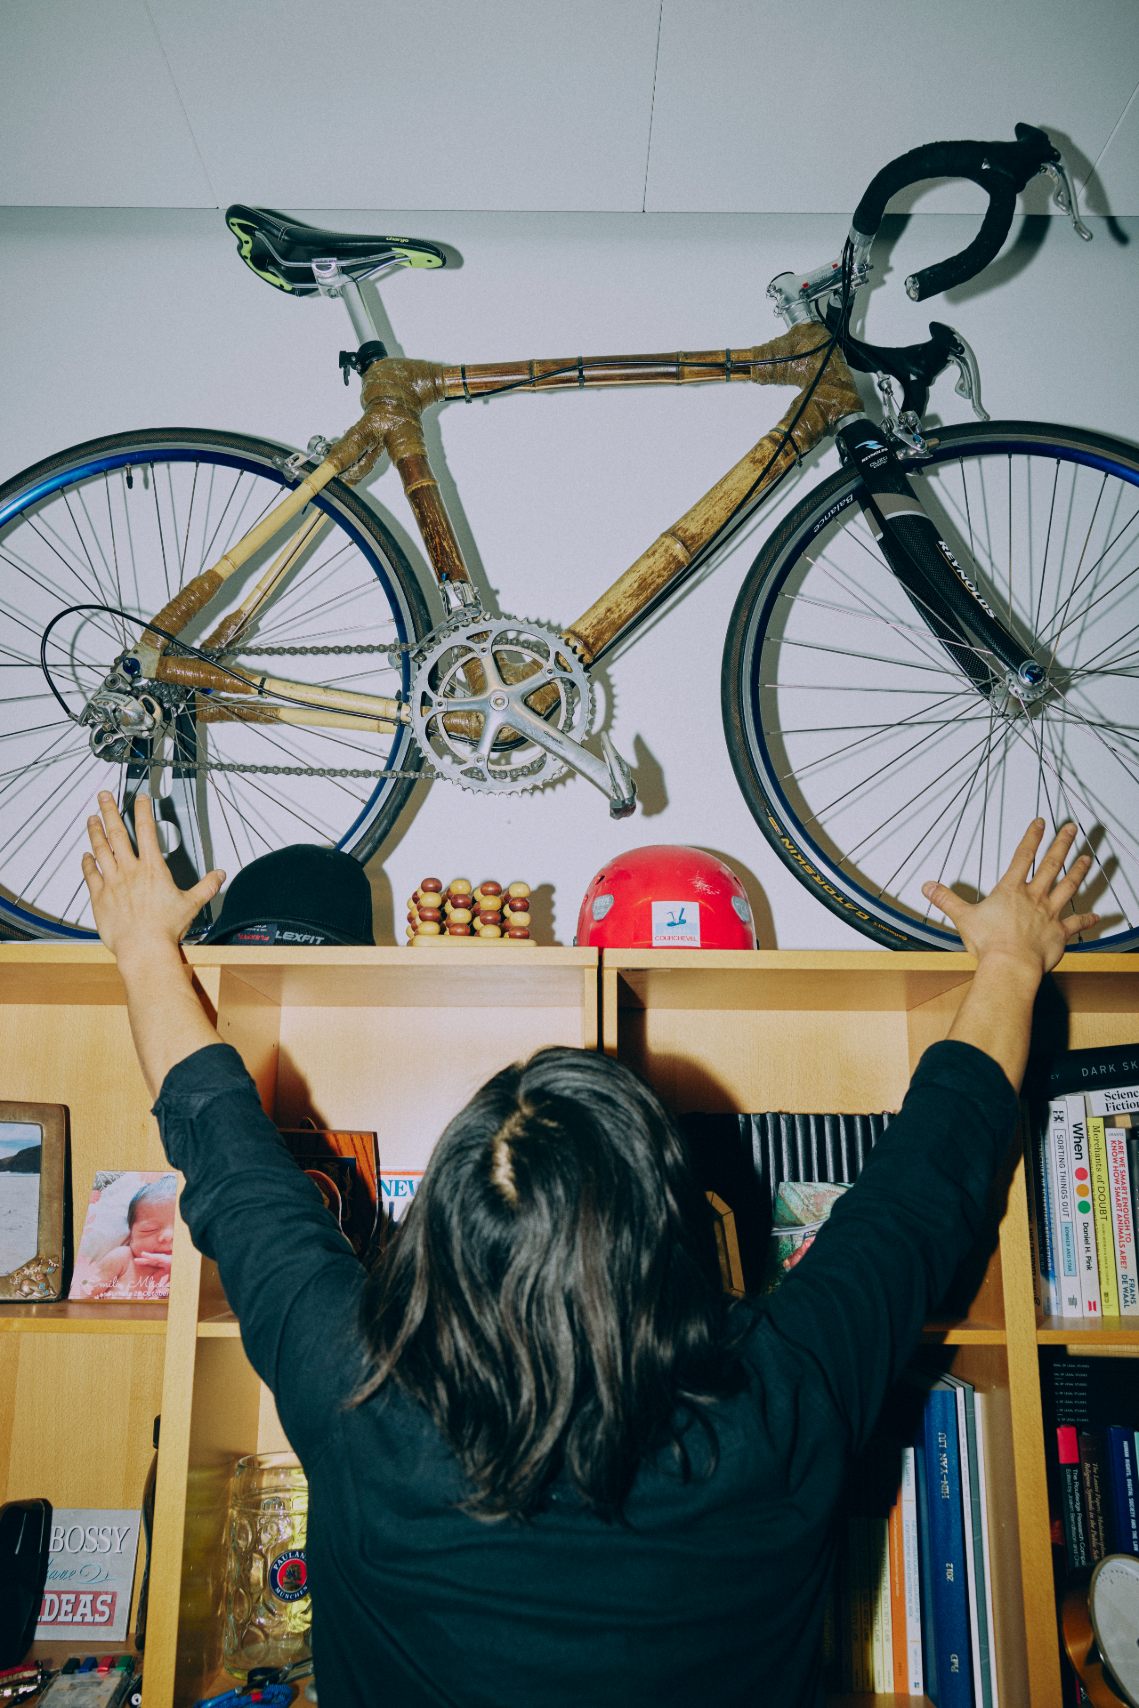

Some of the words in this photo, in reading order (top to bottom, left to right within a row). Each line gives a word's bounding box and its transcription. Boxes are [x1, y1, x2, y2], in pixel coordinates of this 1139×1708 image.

[814, 493, 853, 533] Balance
[938, 541, 997, 618] REYNOLDS
[780, 837, 870, 921] GATORSKIN
[1081, 1063, 1117, 1077] DARK
[1122, 1060, 1139, 1071] SK
[1104, 1088, 1139, 1102] Scienc
[1056, 1134, 1066, 1169] SORTING
[1072, 1122, 1084, 1161] When
[1092, 1125, 1103, 1172] Merchants
[1110, 1139, 1118, 1164] KNOW
[1118, 1156, 1125, 1168] WE
[1059, 1171, 1069, 1199] THINGS
[1096, 1174, 1105, 1184] of
[1120, 1169, 1128, 1195] SMART
[1097, 1186, 1108, 1222] DOUBT
[1114, 1186, 1122, 1212] SMART
[1122, 1196, 1130, 1231] ENOUGH
[1082, 1222, 1091, 1245] Daniel
[1117, 1213, 1126, 1248] ANIMALS
[1125, 1232, 1132, 1243] TO
[1084, 1246, 1091, 1255] H.
[1120, 1249, 1128, 1269] ARE?
[1085, 1256, 1093, 1271] Pink
[1121, 1274, 1128, 1285] DE
[1122, 1286, 1131, 1309] WAAL
[1128, 1278, 1136, 1305] FRANS
[938, 1432, 947, 1448] LIU
[1122, 1440, 1130, 1458] HUMAN
[939, 1452, 950, 1500] HIN-YAN
[1071, 1469, 1079, 1481] The
[1072, 1481, 1081, 1512] Routledge
[1126, 1478, 1134, 1497] DIGITAL
[1127, 1497, 1136, 1518] SOCIETY
[1075, 1512, 1084, 1541] Research
[48, 1524, 131, 1555] BOSSY
[273, 1551, 307, 1570] PAULAN
[1091, 1549, 1099, 1561] Sch
[945, 1562, 954, 1583] 2012
